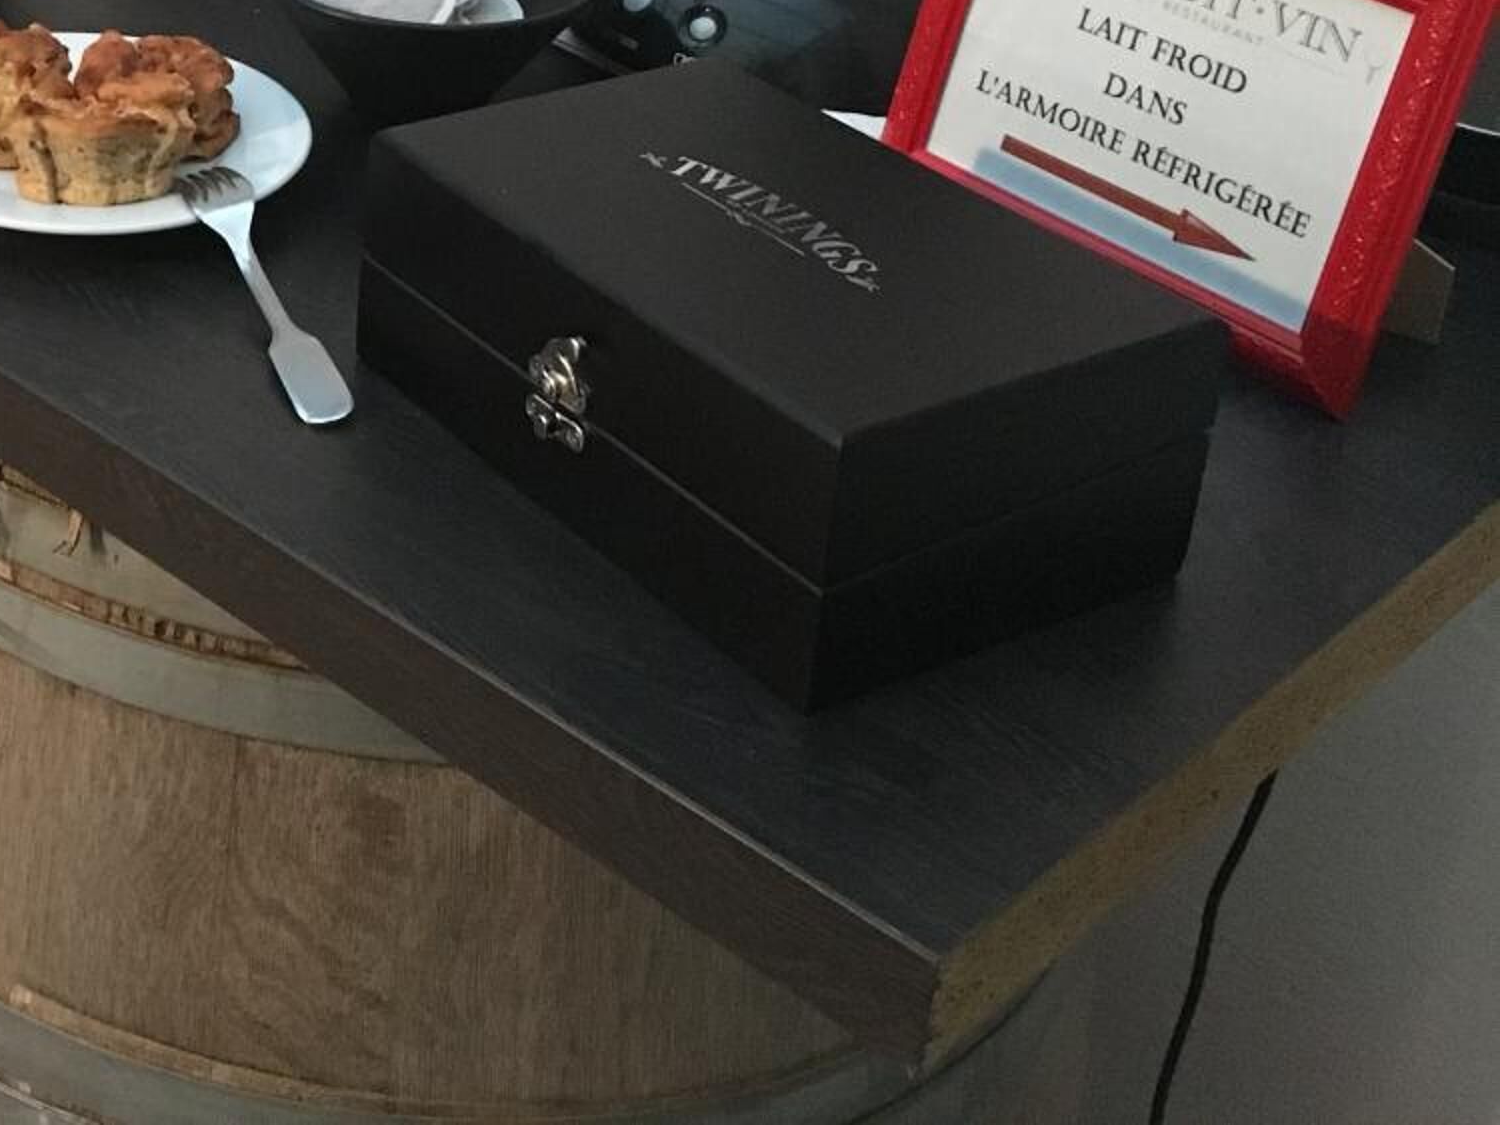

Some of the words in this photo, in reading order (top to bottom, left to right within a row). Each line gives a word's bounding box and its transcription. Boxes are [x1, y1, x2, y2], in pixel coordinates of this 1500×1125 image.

[1076, 6, 1149, 53] LAIT
[1150, 35, 1249, 95] FROID
[1102, 71, 1188, 126] DANS
[975, 69, 1128, 154] L'ARMOIRE
[1130, 137, 1312, 239] RÉFRIGÉRÉE
[670, 155, 880, 275] TWININGS
